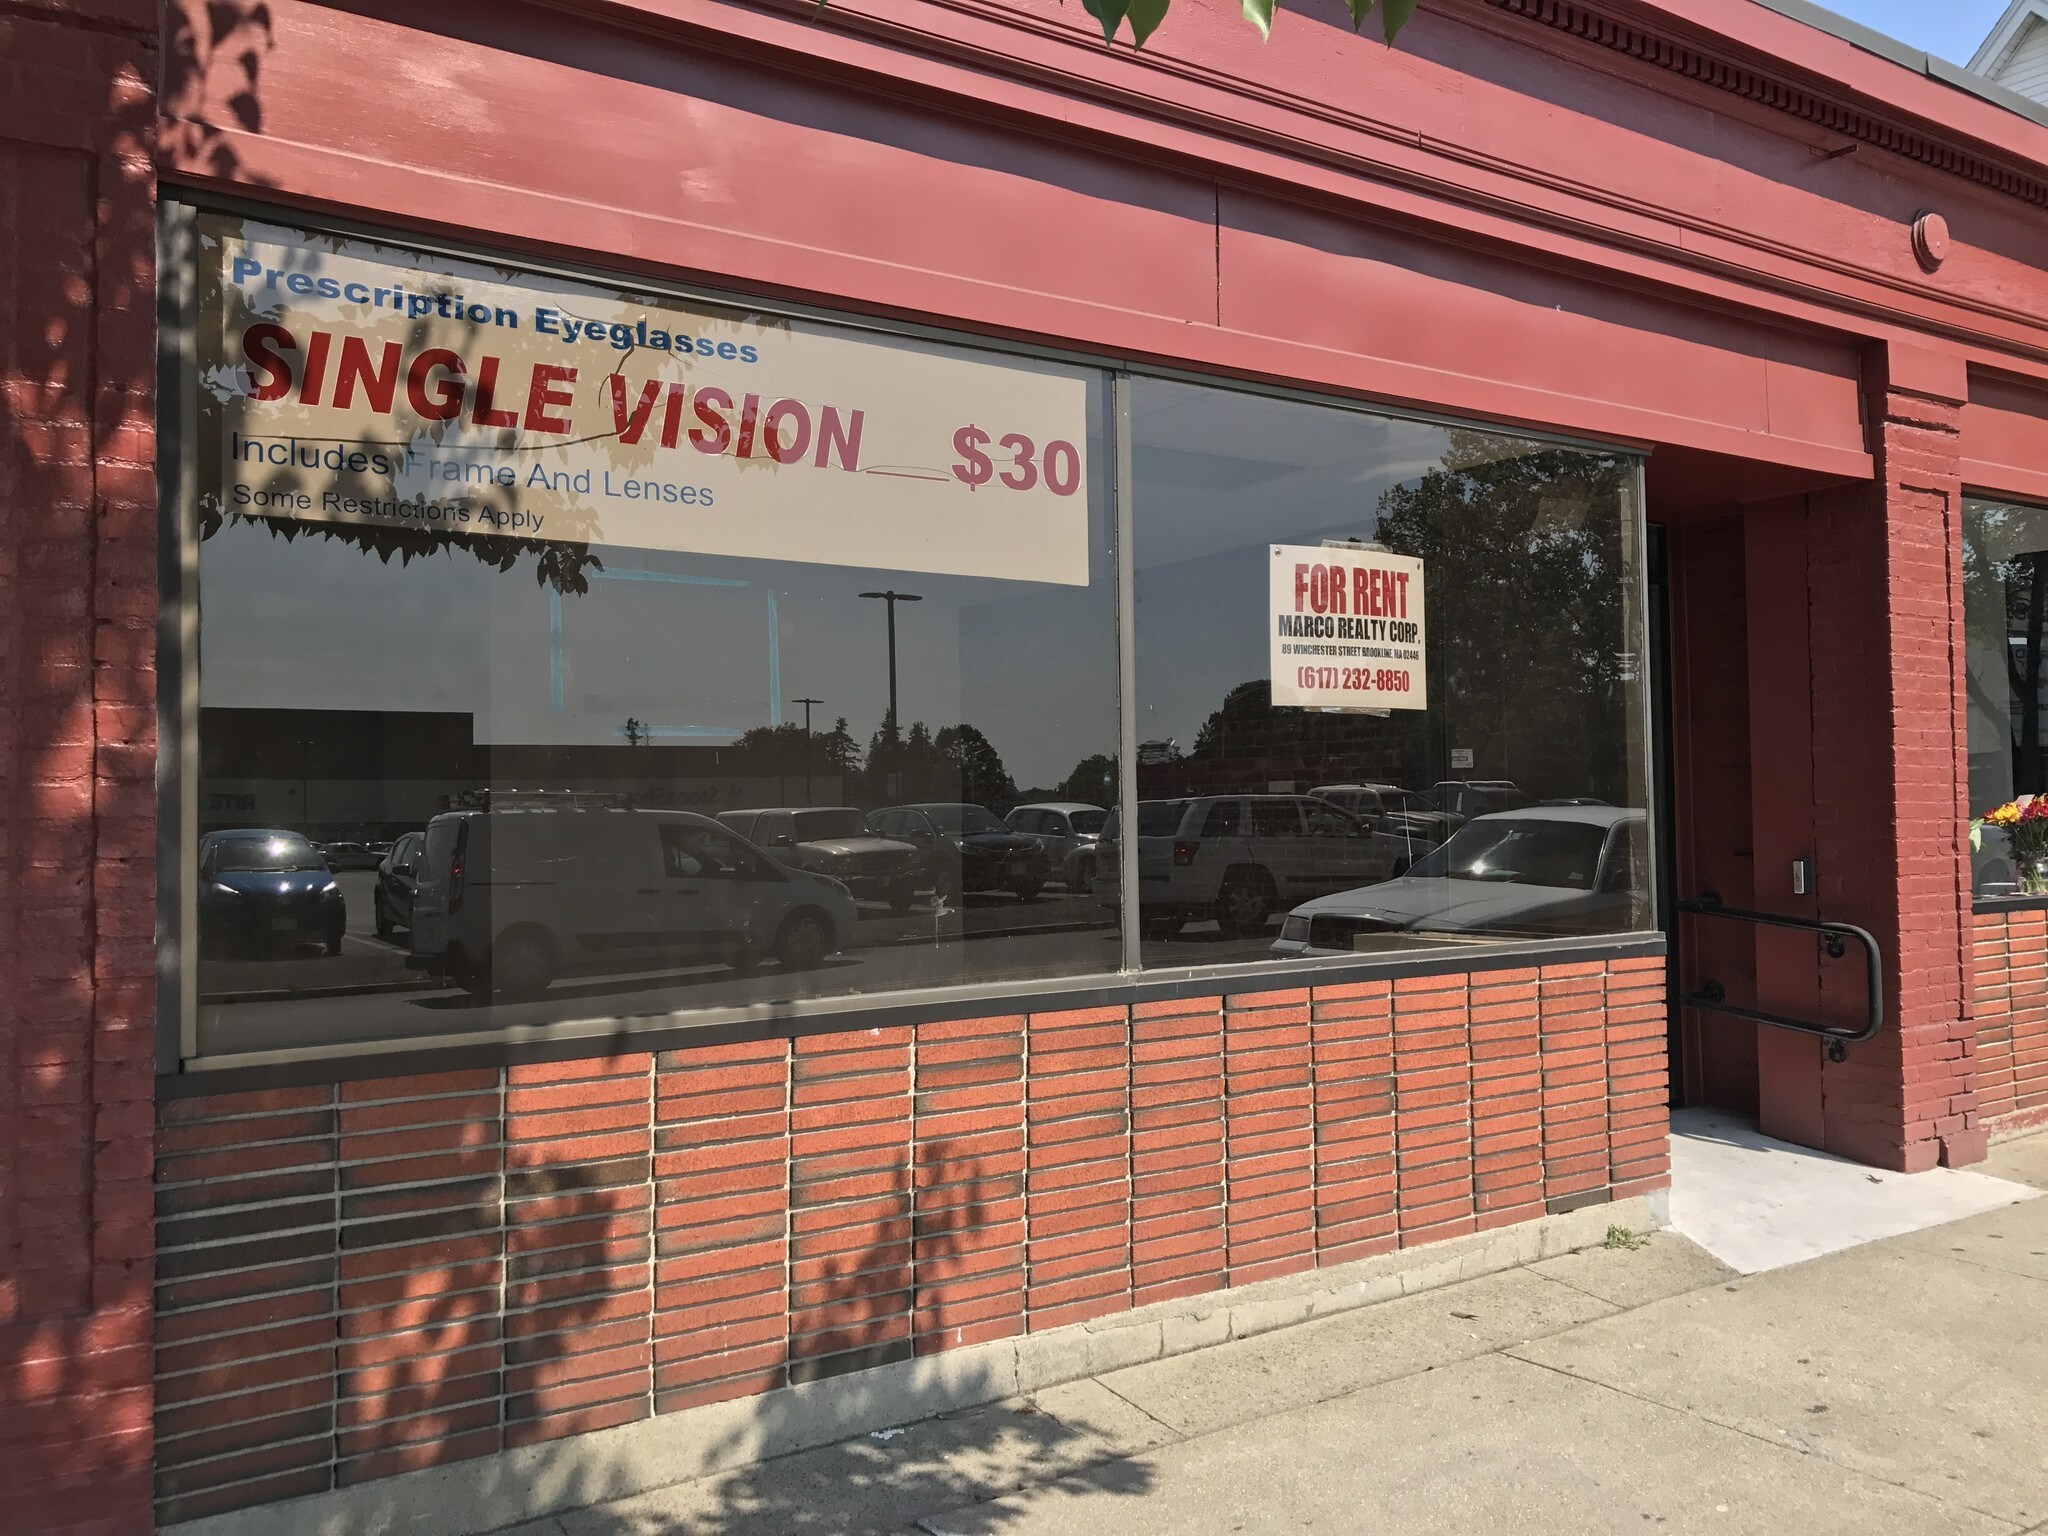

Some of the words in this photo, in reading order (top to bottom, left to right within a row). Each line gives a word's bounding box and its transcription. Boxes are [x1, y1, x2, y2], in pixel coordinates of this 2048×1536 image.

[232, 257, 518, 328] Prescription
[535, 306, 759, 363] Eyeglasses
[237, 323, 579, 435] SINGLE
[609, 374, 865, 472] VISION
[952, 423, 1082, 496] $30
[232, 432, 390, 475] Includes
[403, 450, 516, 488] Frame
[527, 463, 591, 495] And
[604, 471, 714, 507] Lenses
[233, 484, 311, 510] Some
[322, 492, 470, 522] Restrictions
[479, 505, 544, 532] Apply
[1295, 563, 1347, 614] FOR
[1353, 567, 1409, 619] RENT
[1278, 614, 1335, 638] MARCO
[1338, 617, 1388, 642] REALTY
[1281, 643, 1292, 655] 89
[1292, 644, 1337, 656] WINCHESTER
[1338, 645, 1362, 657] STREET
[1394, 649, 1403, 660] MA
[1403, 649, 1420, 660] 02446
[1298, 665, 1339, 689] (617)
[1342, 667, 1410, 692] 232-8850
